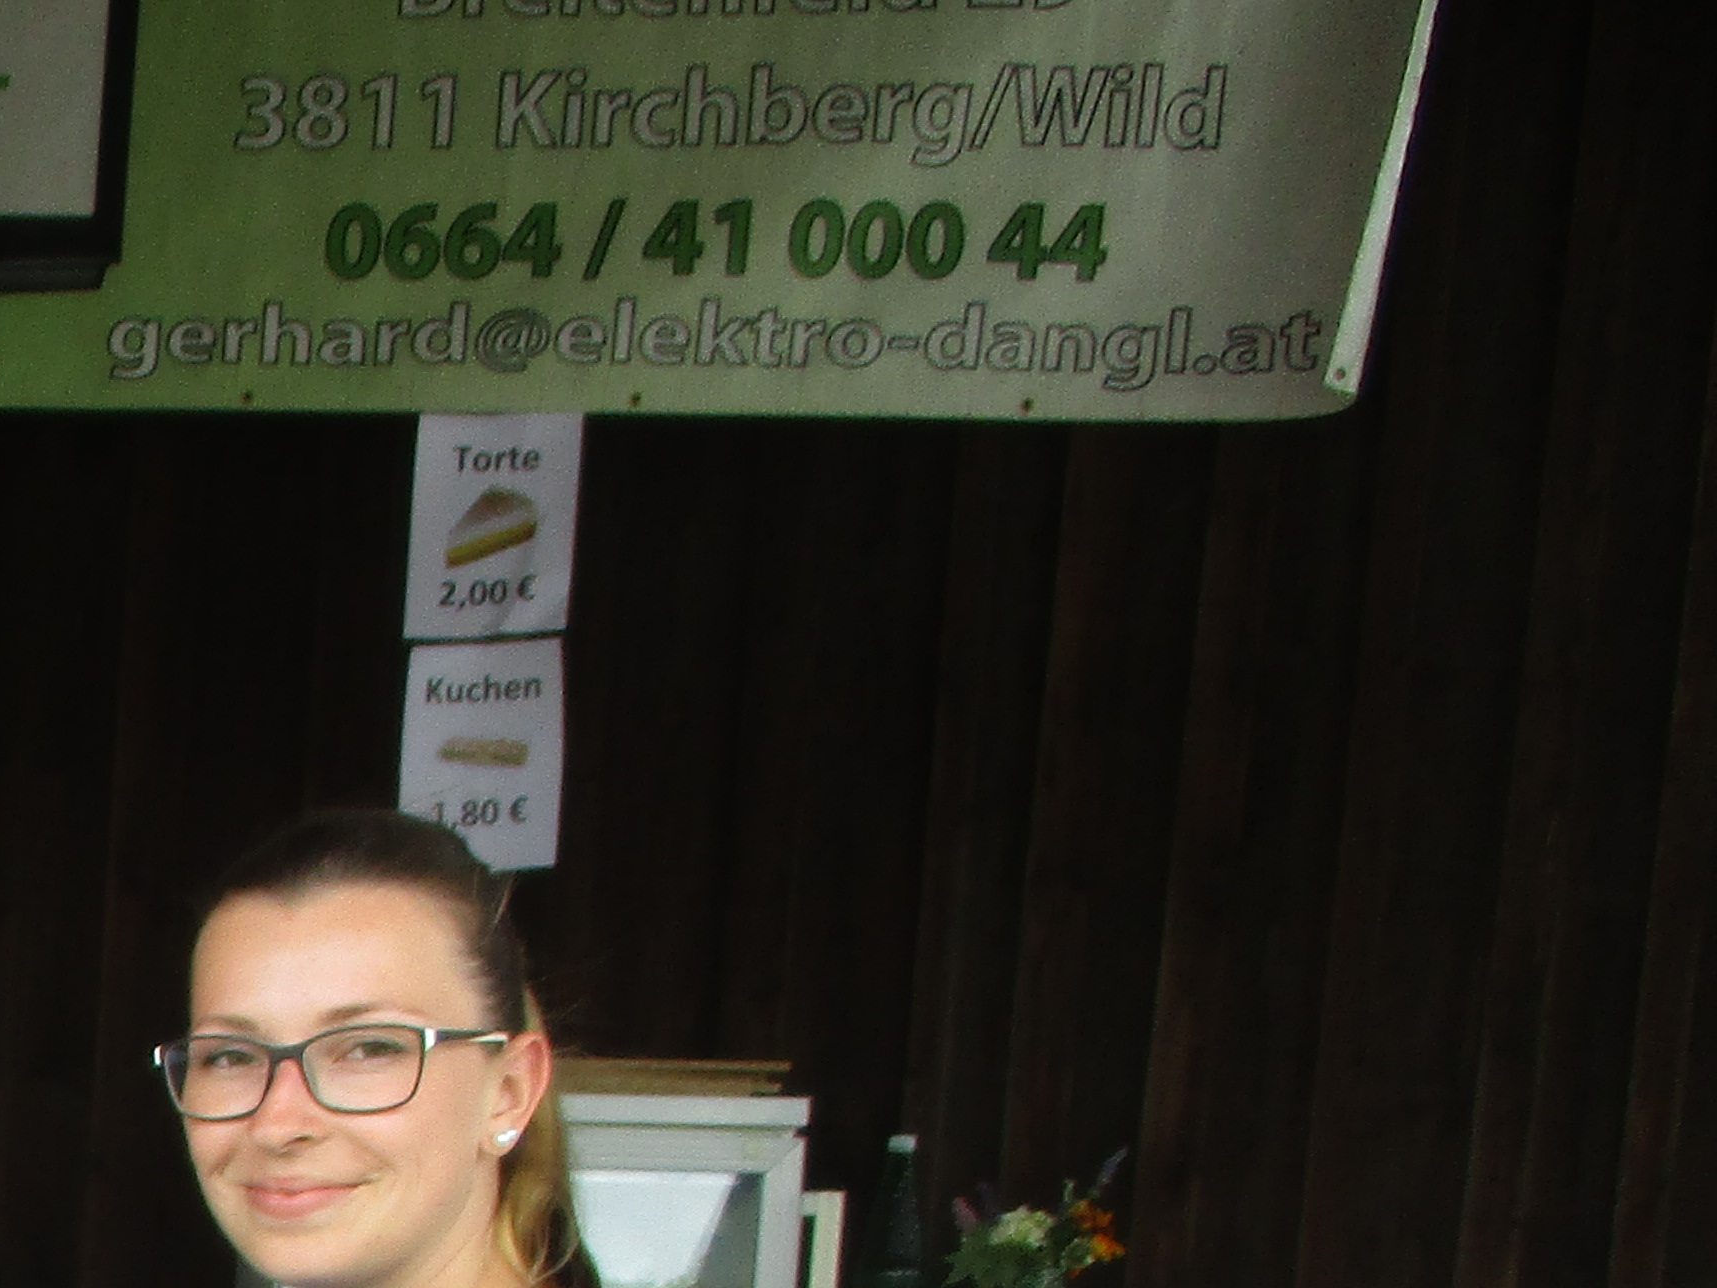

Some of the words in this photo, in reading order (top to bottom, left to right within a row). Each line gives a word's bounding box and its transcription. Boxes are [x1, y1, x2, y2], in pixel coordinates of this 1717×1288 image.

[233, 70, 459, 152] 3811
[493, 62, 1229, 170] Kirchberg/Wild
[323, 201, 563, 284] 0664
[641, 199, 754, 279] 41
[788, 200, 965, 280] 000
[985, 201, 1108, 283] 44
[105, 296, 1321, 390] gerhard@elektro-dangl.at
[451, 444, 542, 474] Torte
[438, 578, 509, 610] 2,00
[516, 573, 538, 602] €
[424, 673, 543, 705] Kuchen
[508, 794, 529, 824] €
